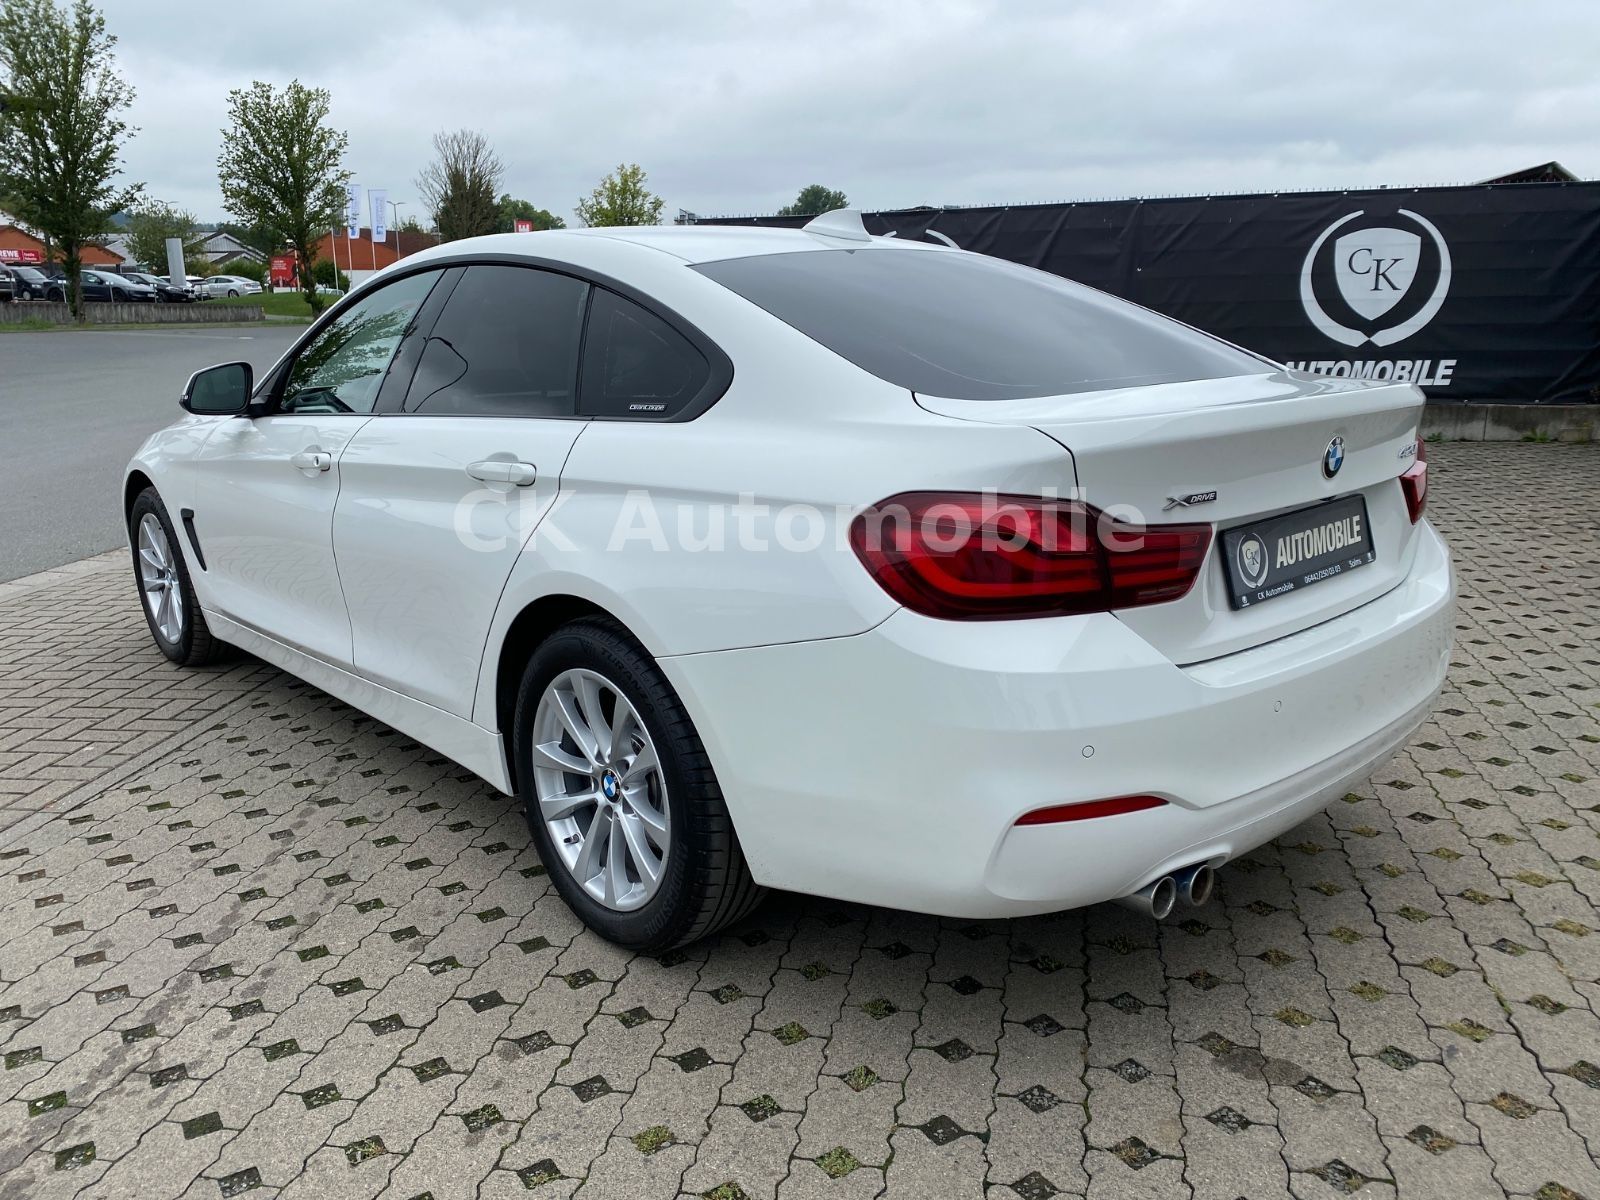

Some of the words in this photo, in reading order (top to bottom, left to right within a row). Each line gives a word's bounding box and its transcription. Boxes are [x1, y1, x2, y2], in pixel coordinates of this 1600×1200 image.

[1349, 248, 1404, 291] CK
[1246, 548, 1259, 566] CK
[1276, 515, 1362, 569] AUTOMOBILE
[1265, 582, 1294, 598] Automobile
